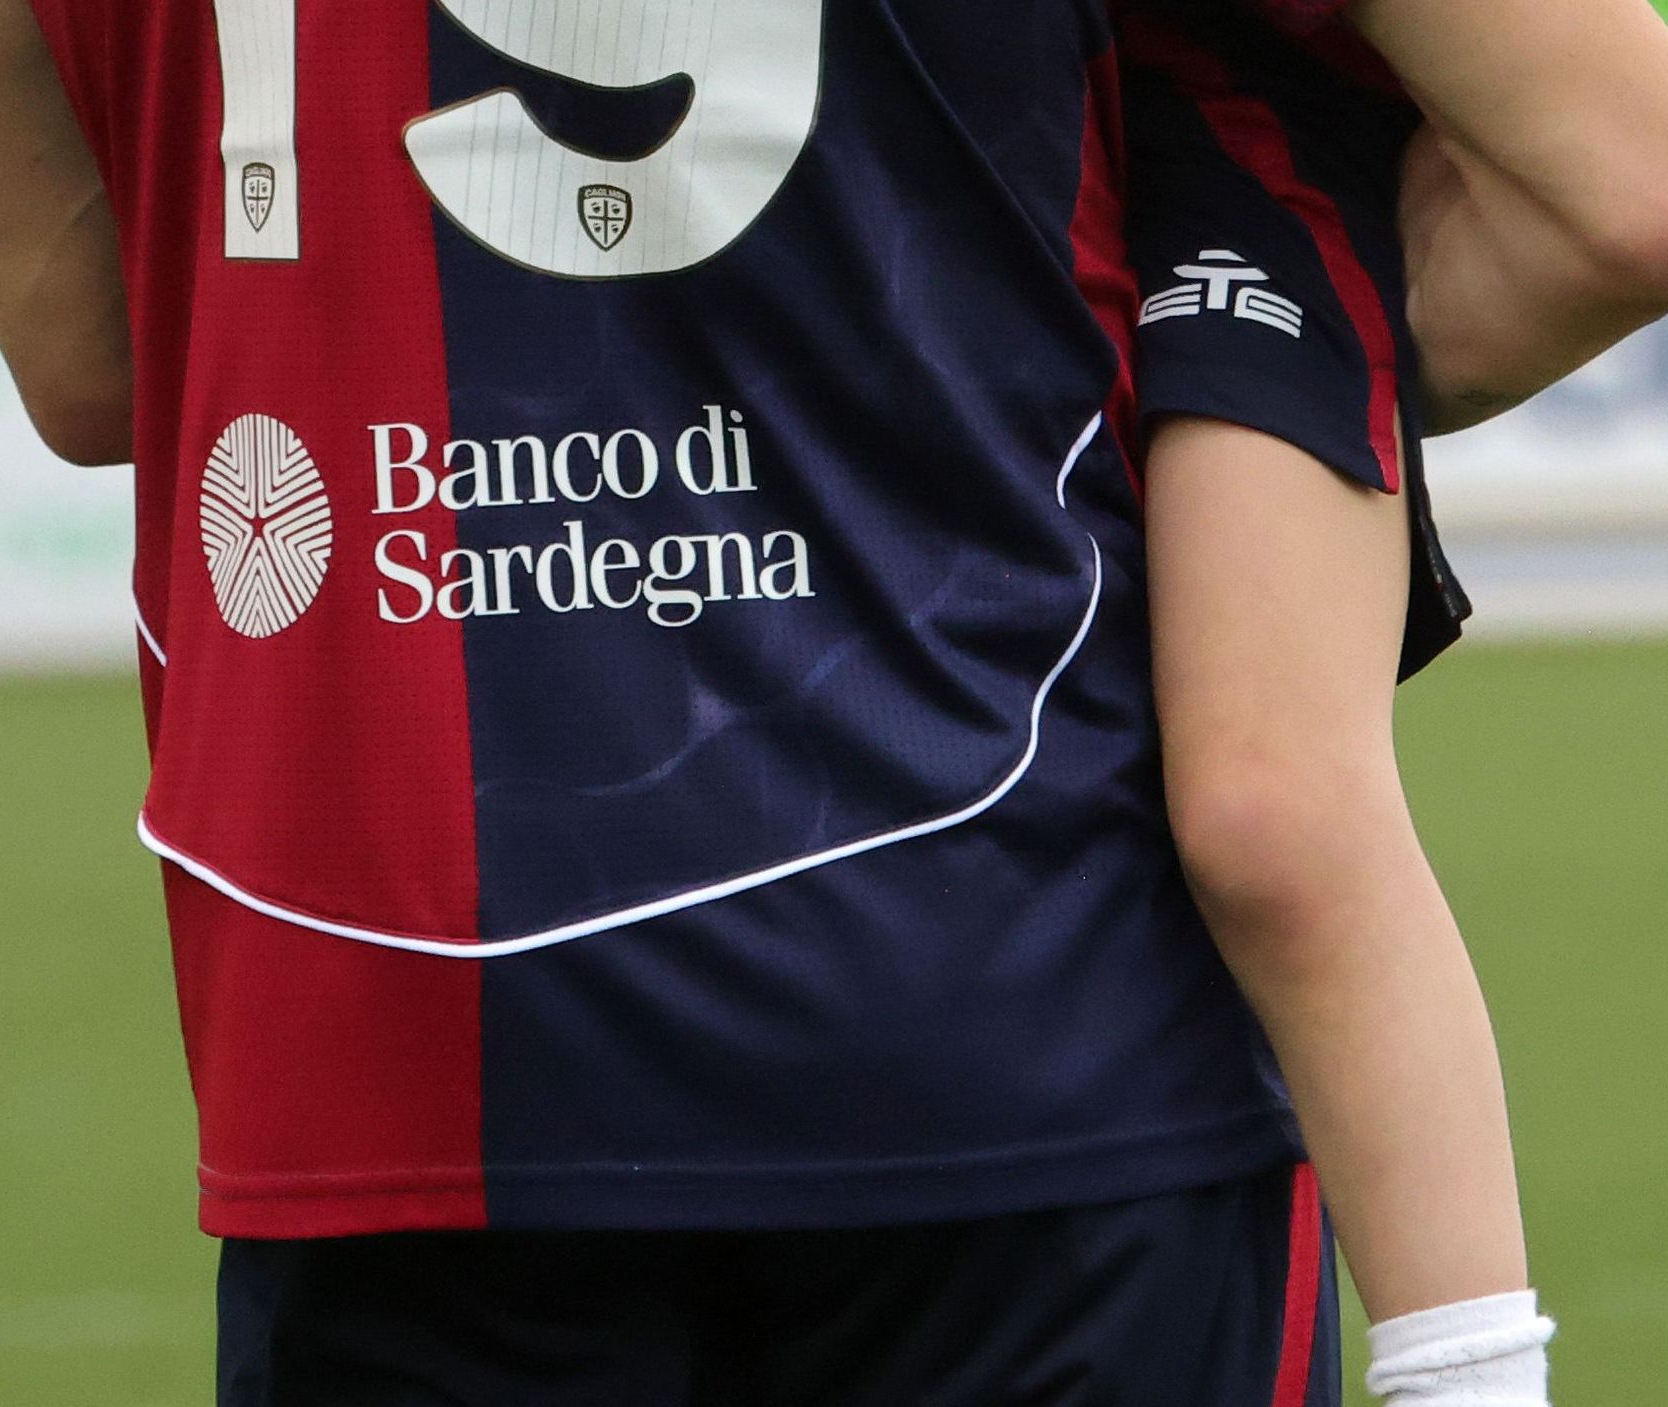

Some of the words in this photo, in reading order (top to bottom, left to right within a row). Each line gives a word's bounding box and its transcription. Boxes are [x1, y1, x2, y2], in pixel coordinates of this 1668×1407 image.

[367, 421, 659, 514] Banco
[676, 404, 758, 494] di
[374, 520, 815, 627] Sardegna
